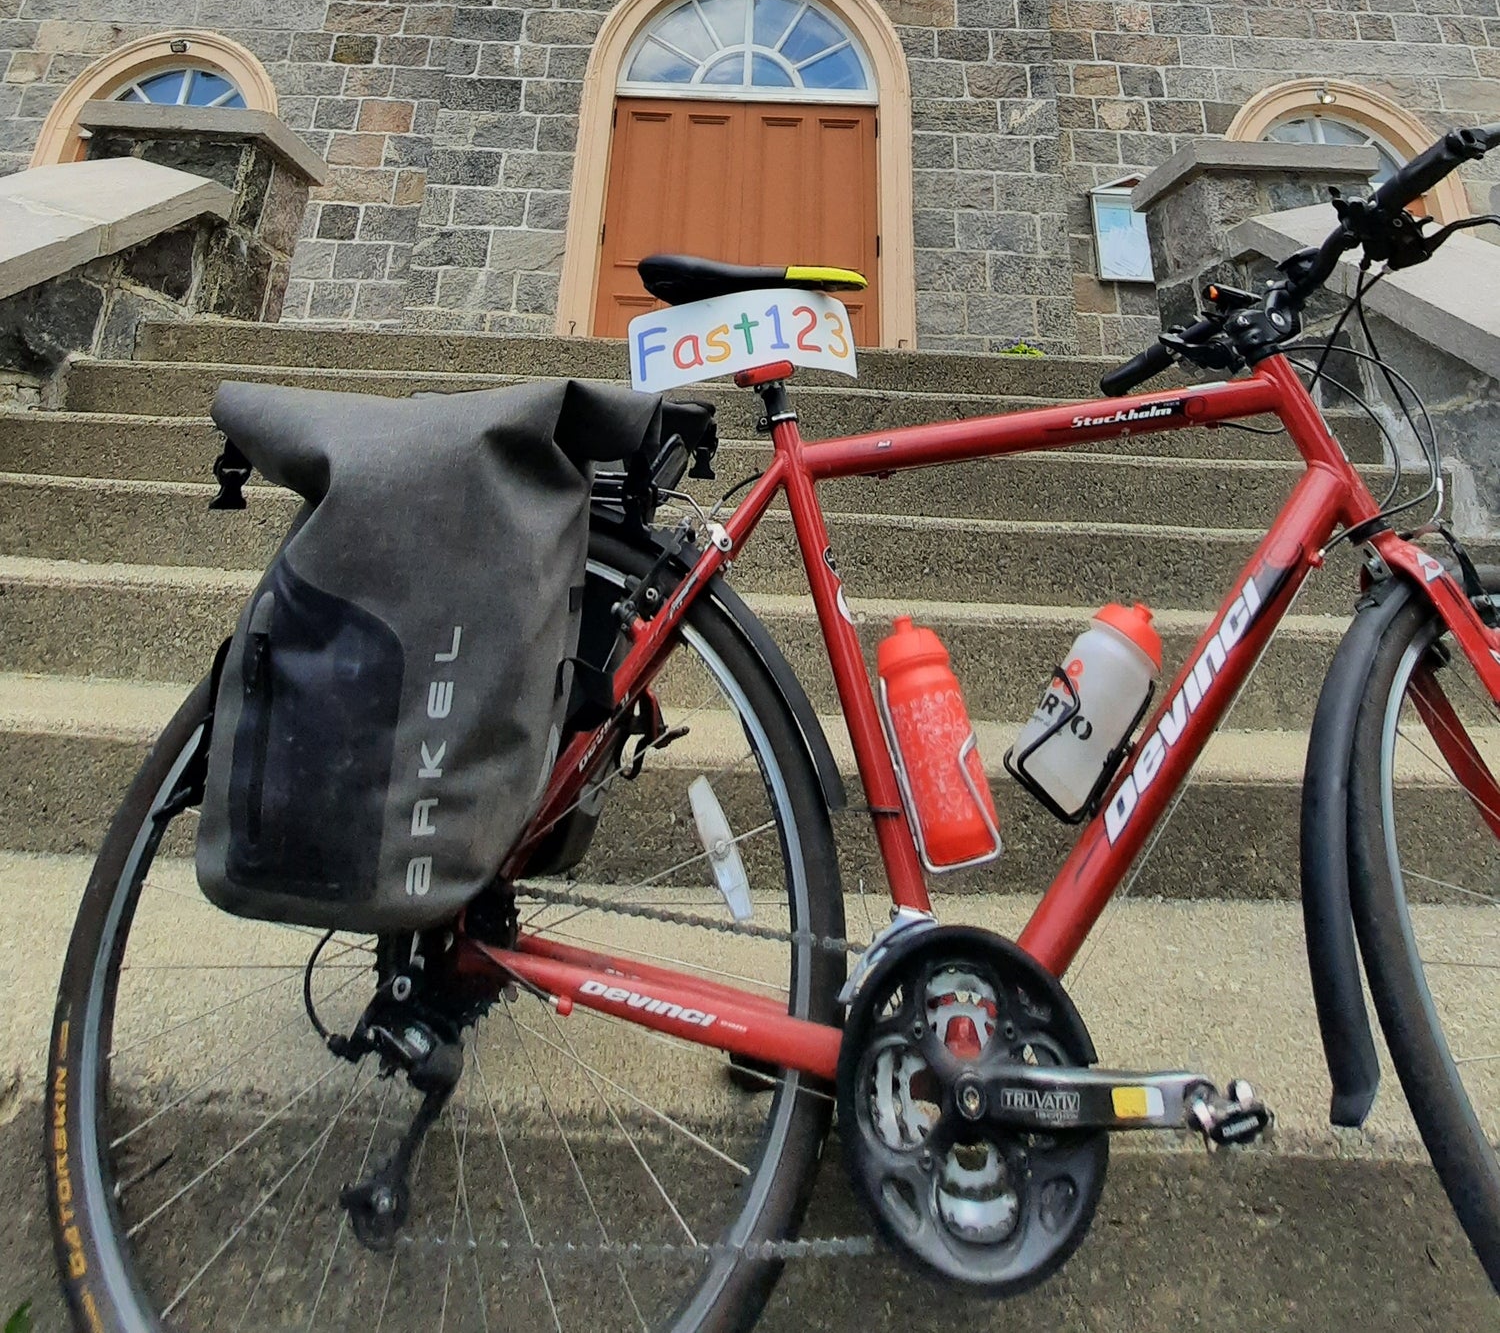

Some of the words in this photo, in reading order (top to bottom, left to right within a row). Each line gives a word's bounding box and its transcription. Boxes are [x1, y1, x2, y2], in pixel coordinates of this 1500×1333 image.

[637, 304, 849, 382] Fast123
[1071, 405, 1172, 428] Stockholm
[1004, 1090, 1077, 1112] TRUVATIV
